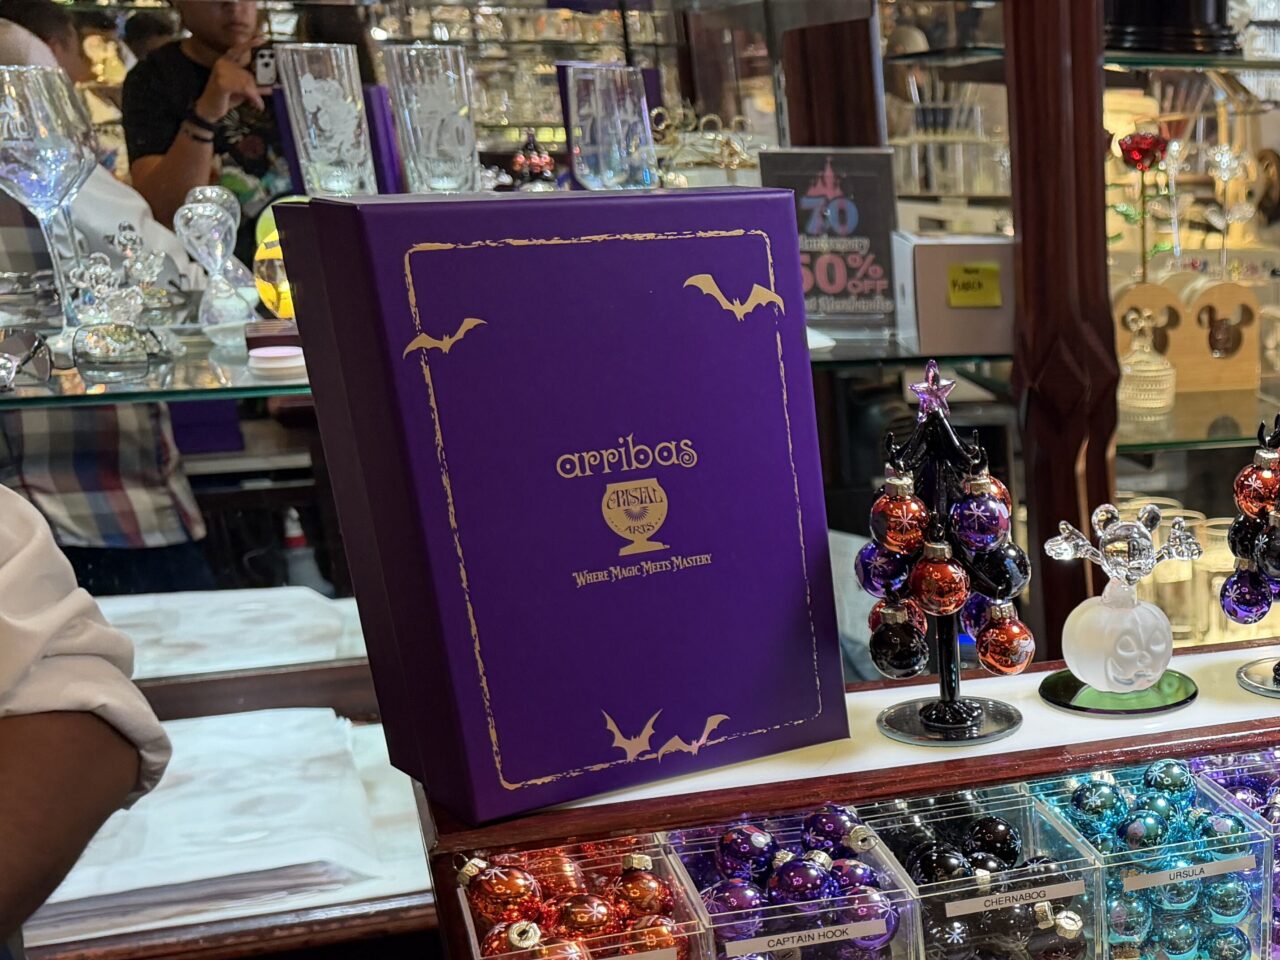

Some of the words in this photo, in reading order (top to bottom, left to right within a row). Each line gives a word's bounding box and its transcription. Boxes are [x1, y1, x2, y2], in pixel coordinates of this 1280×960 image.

[799, 196, 859, 235] 70
[847, 280, 888, 294] OFF
[556, 432, 698, 479] arribas
[606, 486, 664, 510] CRISTAL
[624, 522, 656, 536] ARTS
[572, 569, 610, 588] WHERE
[610, 564, 641, 583] MAGIC
[640, 559, 672, 577] MEETS
[671, 553, 712, 573] MASTERY
[1168, 867, 1205, 881] URSULA
[984, 890, 1047, 908] CHERNABOG
[767, 934, 815, 948] CAPTAIN
[818, 928, 849, 940] HOOK
